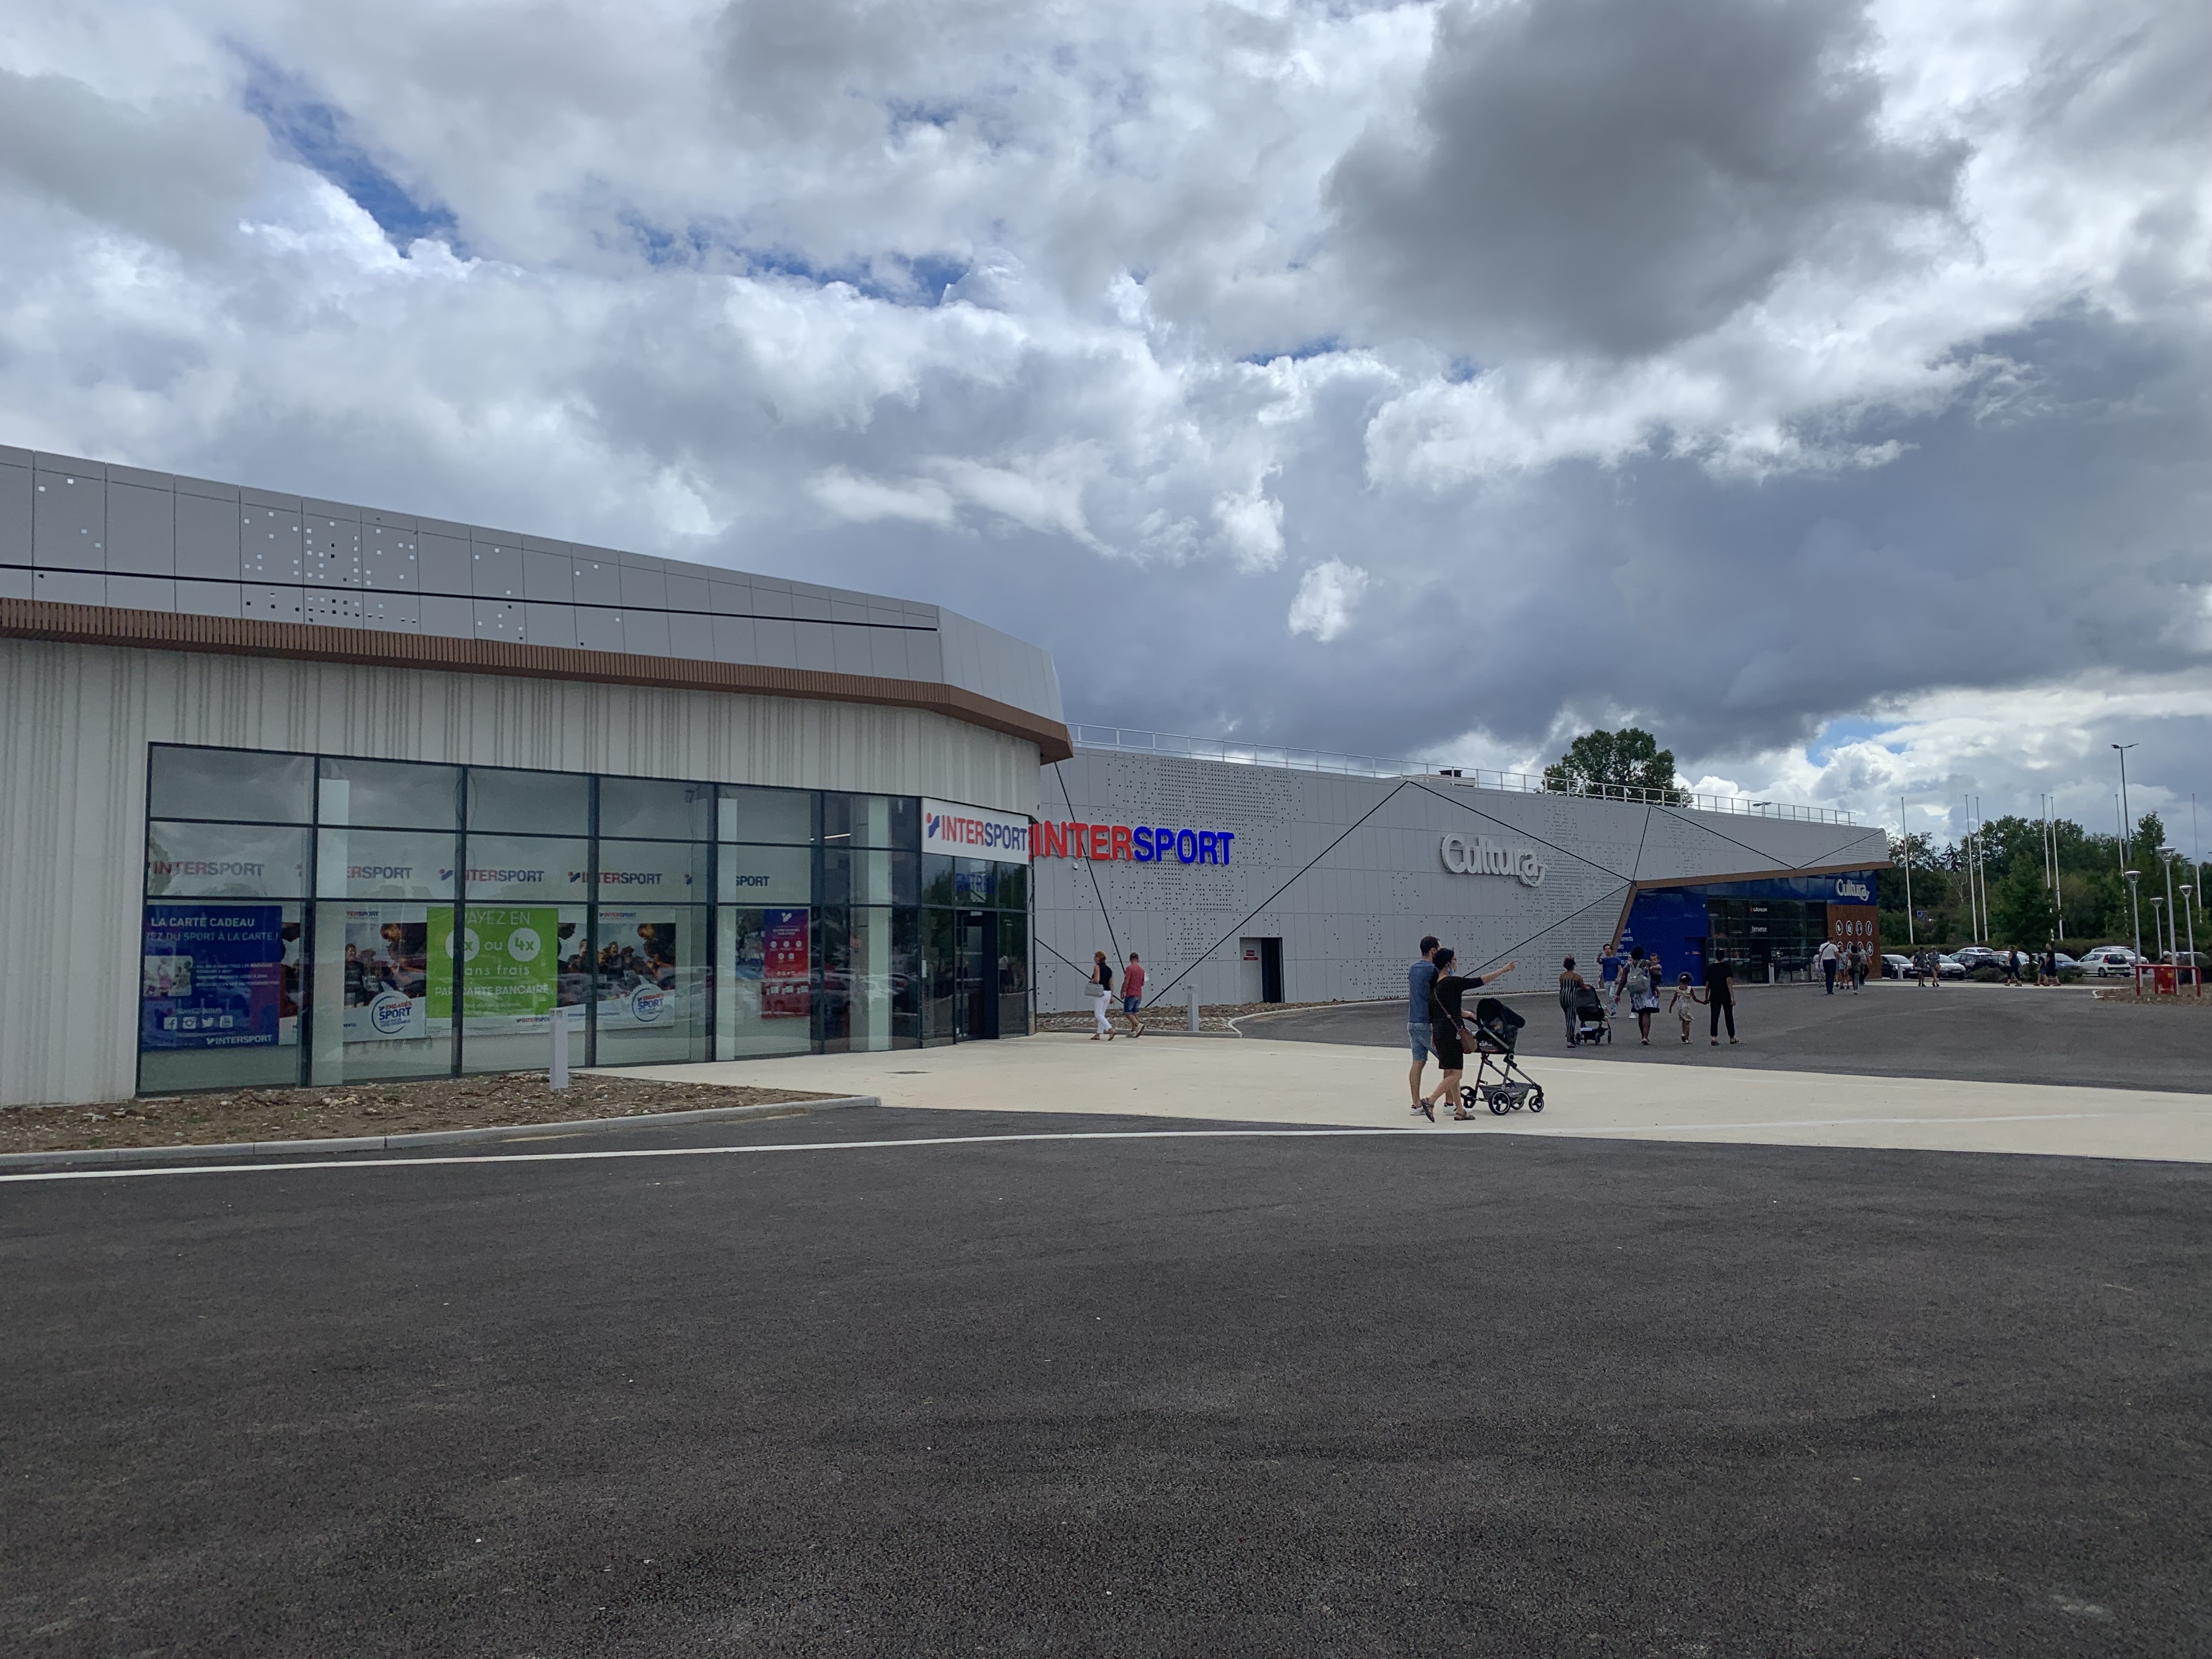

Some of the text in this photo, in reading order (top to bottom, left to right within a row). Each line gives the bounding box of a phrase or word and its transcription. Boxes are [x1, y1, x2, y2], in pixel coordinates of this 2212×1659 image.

[941, 815, 1028, 851] INTERSPORT
[1032, 820, 1234, 865] INTERSPORT
[1442, 833, 1548, 887] Cultura
[153, 860, 264, 877] INTERSPORT
[347, 866, 413, 879] ERSPORT
[582, 871, 663, 885] ITERSPORT
[736, 876, 770, 887] SPORT
[1835, 878, 1870, 901] Cultura
[151, 917, 255, 927] LA CARTE CADEAU
[467, 911, 531, 926] AYEZ EN
[166, 932, 180, 941] DU
[183, 932, 215, 941] SPORT
[228, 932, 240, 941] LA
[242, 932, 273, 941] CARTE
[484, 941, 503, 951] ou
[514, 937, 534, 951] 4x
[465, 965, 530, 976] ans frais
[495, 983, 549, 995] BANCAIRE
[379, 1007, 412, 1020] SPORT
[216, 1035, 273, 1045] INTERSPORT
